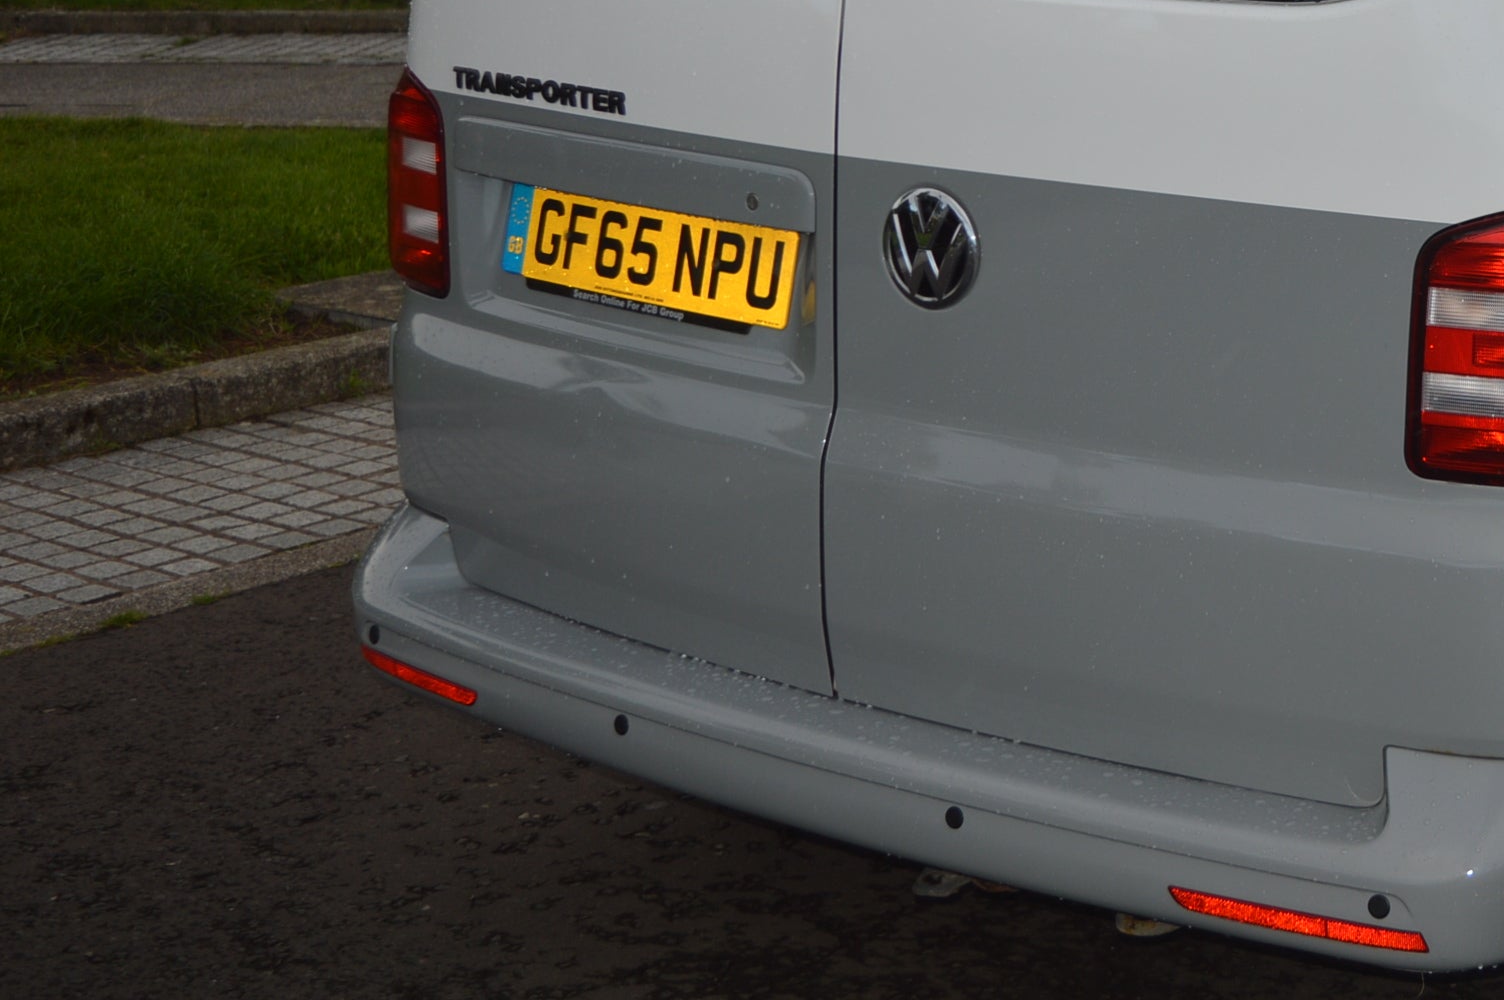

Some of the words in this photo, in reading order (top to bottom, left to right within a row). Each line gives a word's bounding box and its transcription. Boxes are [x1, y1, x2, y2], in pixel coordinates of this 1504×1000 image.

[453, 66, 626, 115] TRANSPORTER
[508, 235, 524, 254] GB
[534, 197, 663, 287] GF65
[671, 223, 786, 310] NPU
[573, 289, 599, 303] Search
[601, 295, 625, 308] Online
[626, 300, 640, 311] For
[641, 303, 658, 315] JCB
[659, 307, 685, 321] Group
